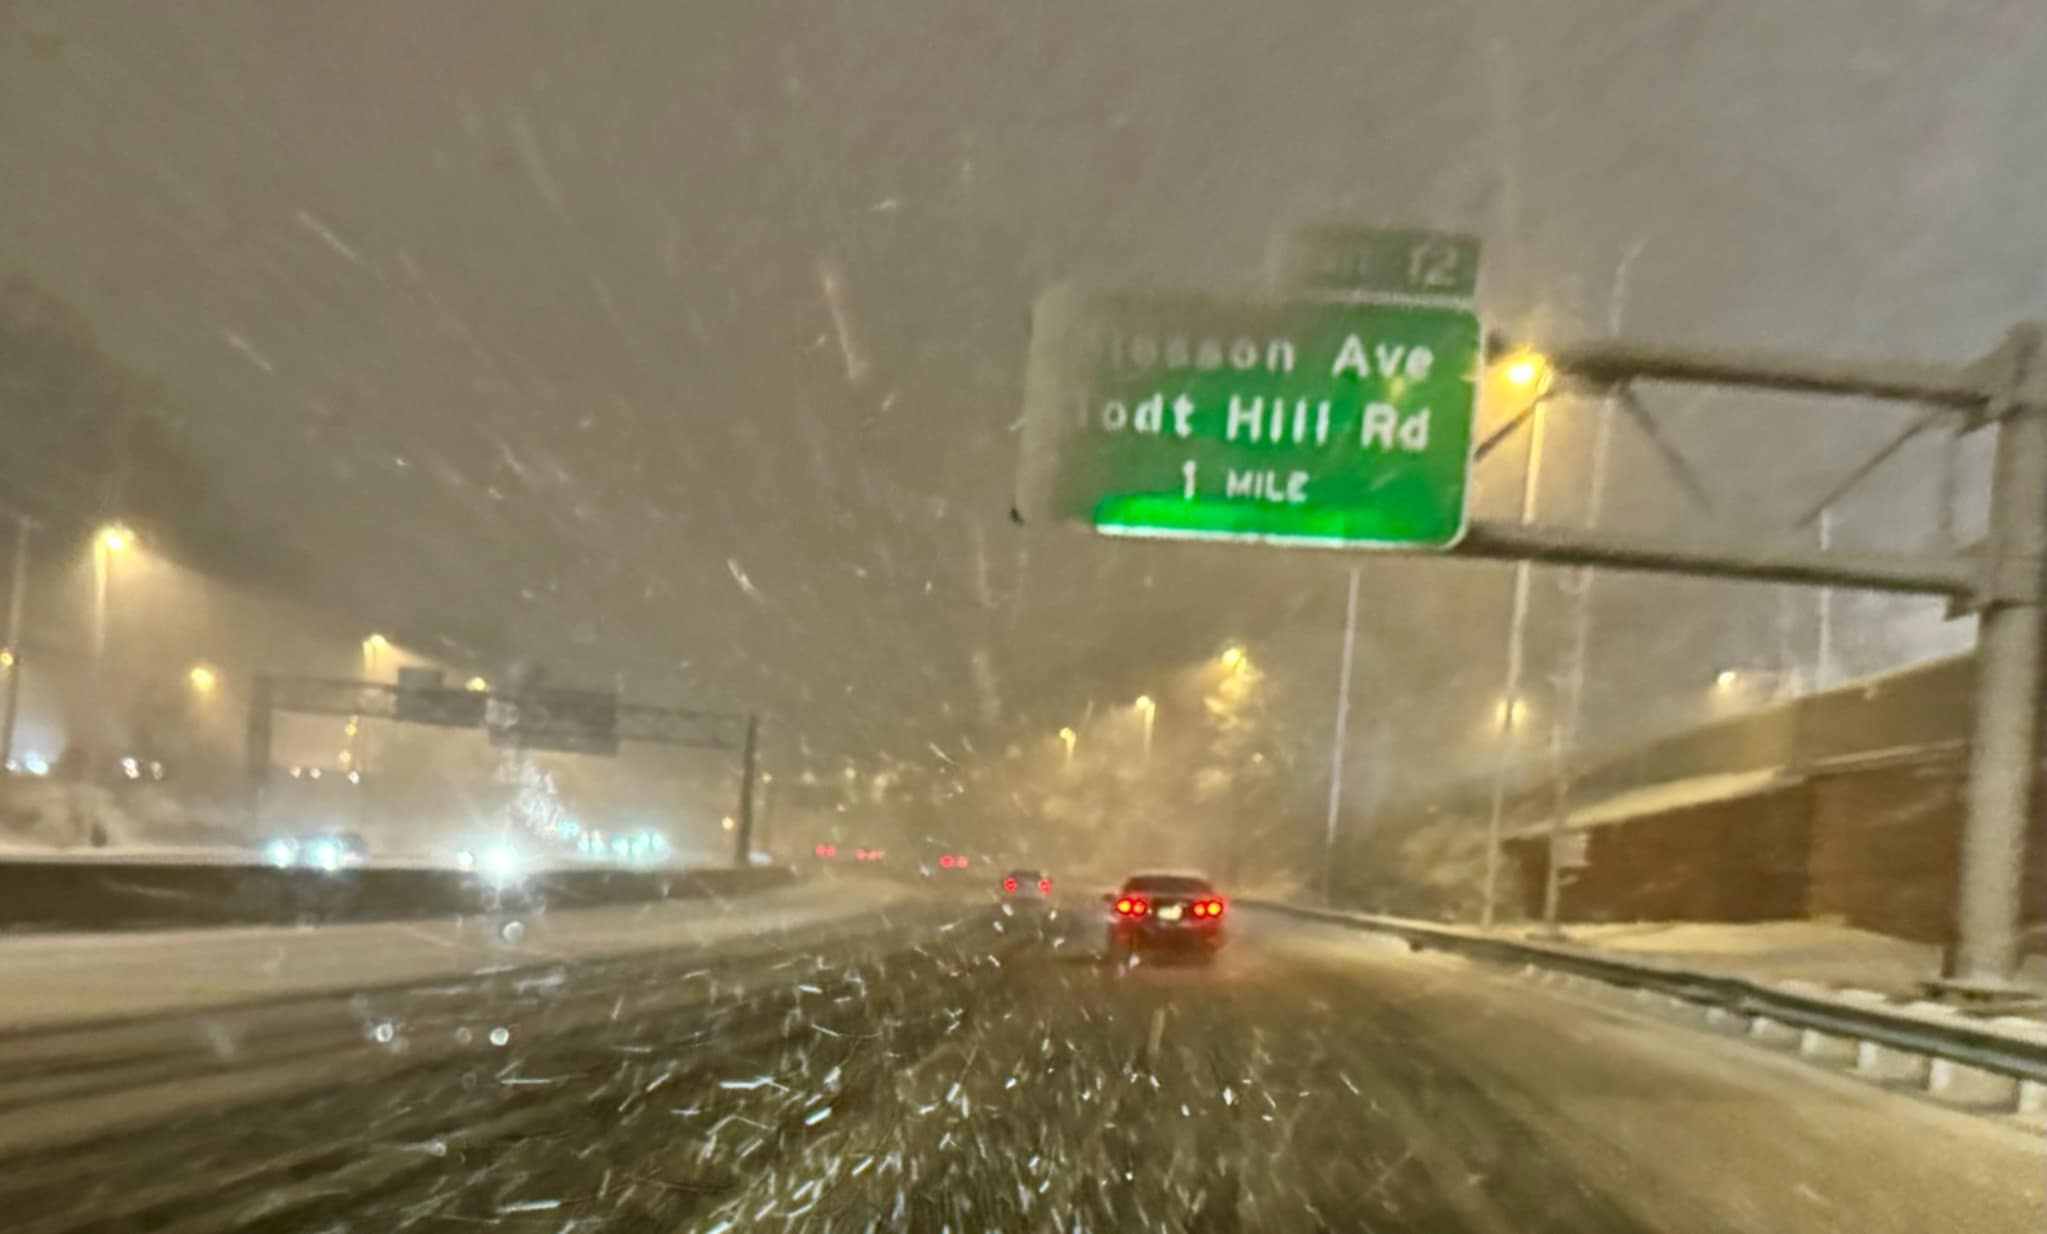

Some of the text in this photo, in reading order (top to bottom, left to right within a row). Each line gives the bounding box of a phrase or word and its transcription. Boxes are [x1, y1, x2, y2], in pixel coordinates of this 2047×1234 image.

[1408, 242, 1458, 287] 12
[1082, 332, 1435, 382] losson Ave
[1225, 395, 1331, 447] Hill
[1361, 403, 1432, 453] Rd
[1182, 460, 1311, 504] 1 MILE
